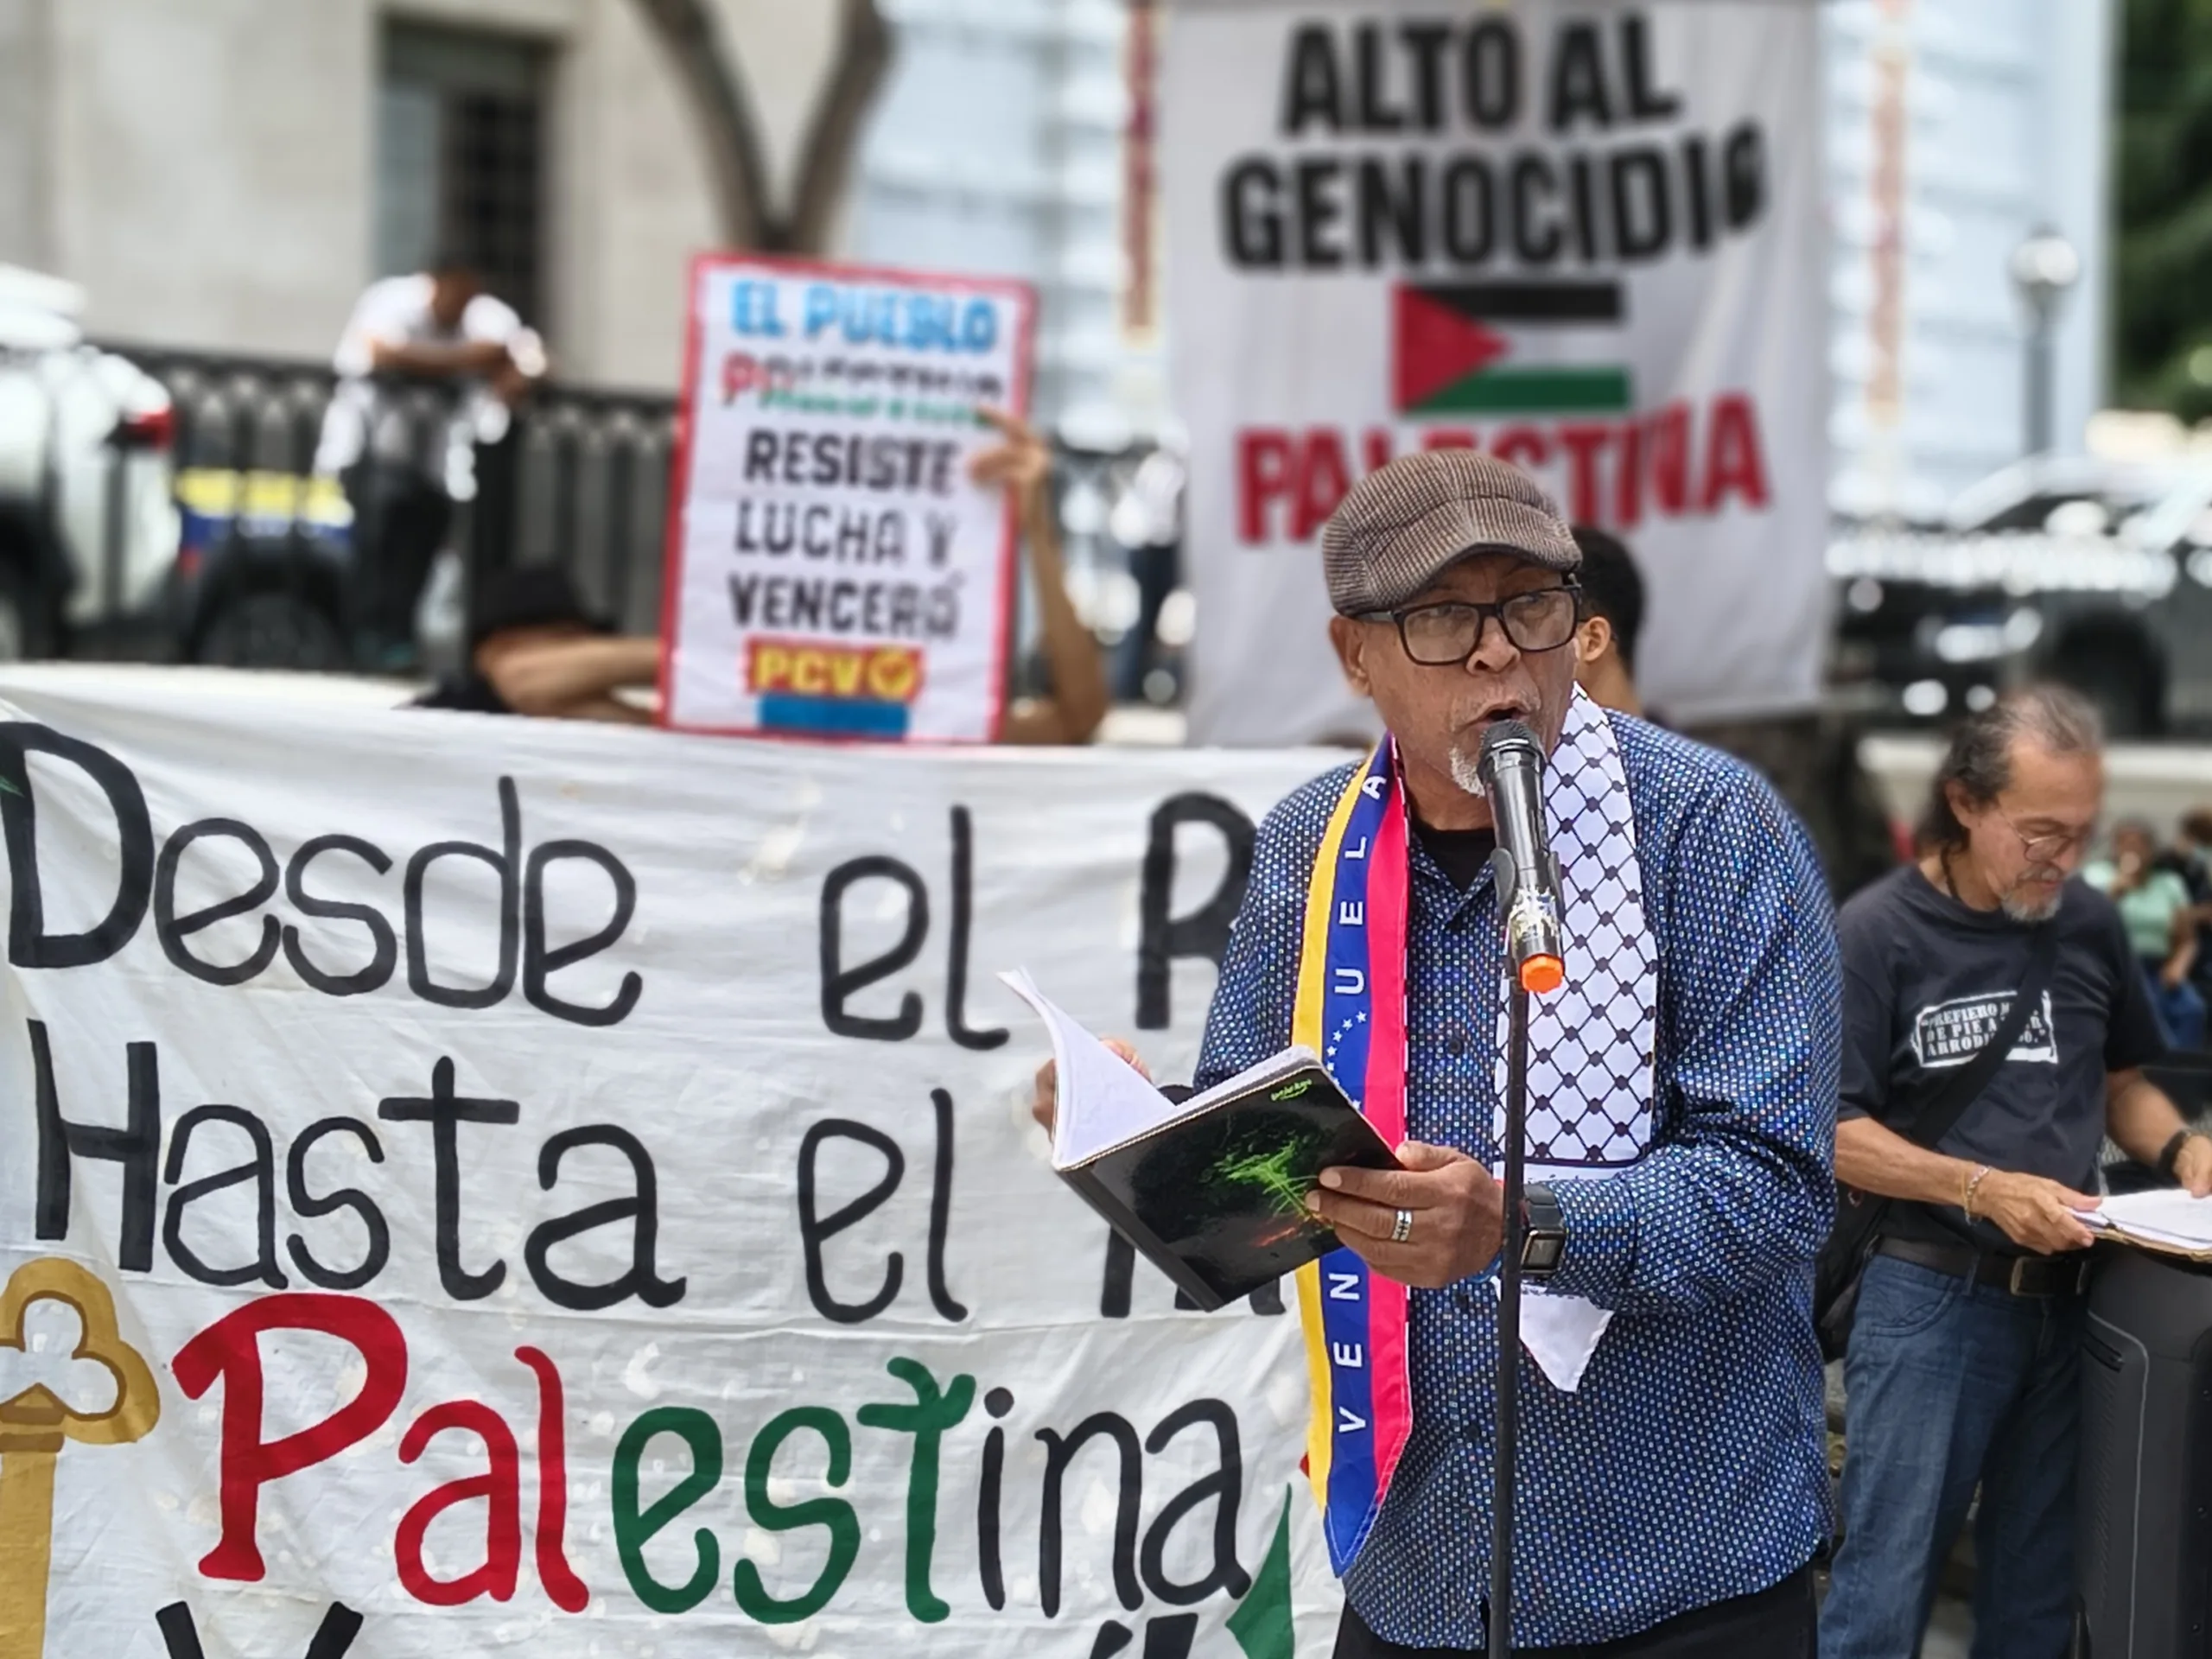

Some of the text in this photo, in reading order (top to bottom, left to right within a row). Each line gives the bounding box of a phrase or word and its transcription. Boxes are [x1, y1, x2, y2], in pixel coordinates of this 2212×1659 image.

[1281, 14, 1681, 137] ALTO AL
[1222, 119, 1768, 271] GENOCIDIO
[732, 281, 997, 355] EL PUEBLO
[744, 428, 957, 496] RESISTE
[735, 499, 958, 567] LUCHA Y
[756, 647, 863, 694] PCV
[0, 721, 643, 1027] Desde
[819, 804, 1010, 1050] el
[1952, 1020, 1982, 1038] PIE
[27, 1017, 969, 1324] Hasta el
[172, 1292, 1253, 1624] Palestina
